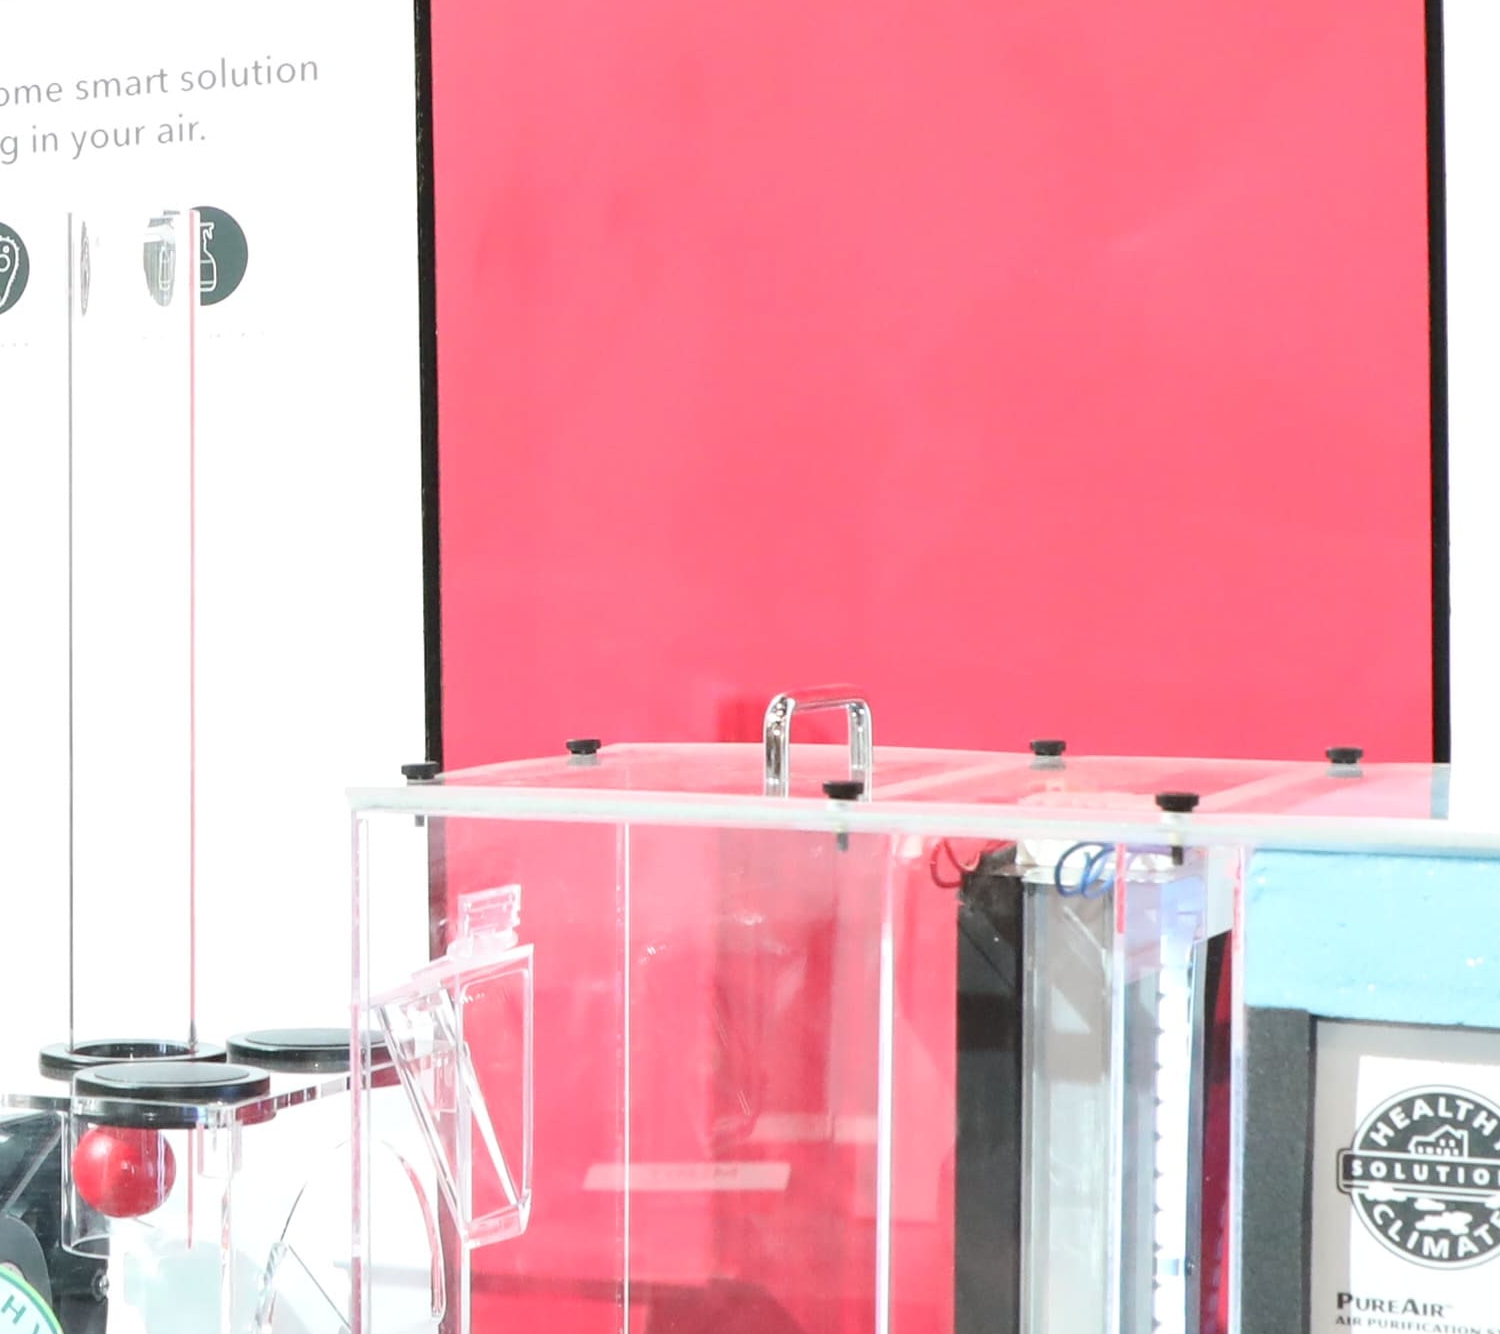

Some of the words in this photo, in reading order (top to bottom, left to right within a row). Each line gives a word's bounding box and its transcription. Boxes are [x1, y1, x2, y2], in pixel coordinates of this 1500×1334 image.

[75, 67, 169, 100] smart
[180, 54, 319, 94] solution
[32, 125, 59, 153] in
[71, 120, 145, 154] your
[157, 111, 206, 145] air.
[1334, 1313, 1362, 1327] AIR
